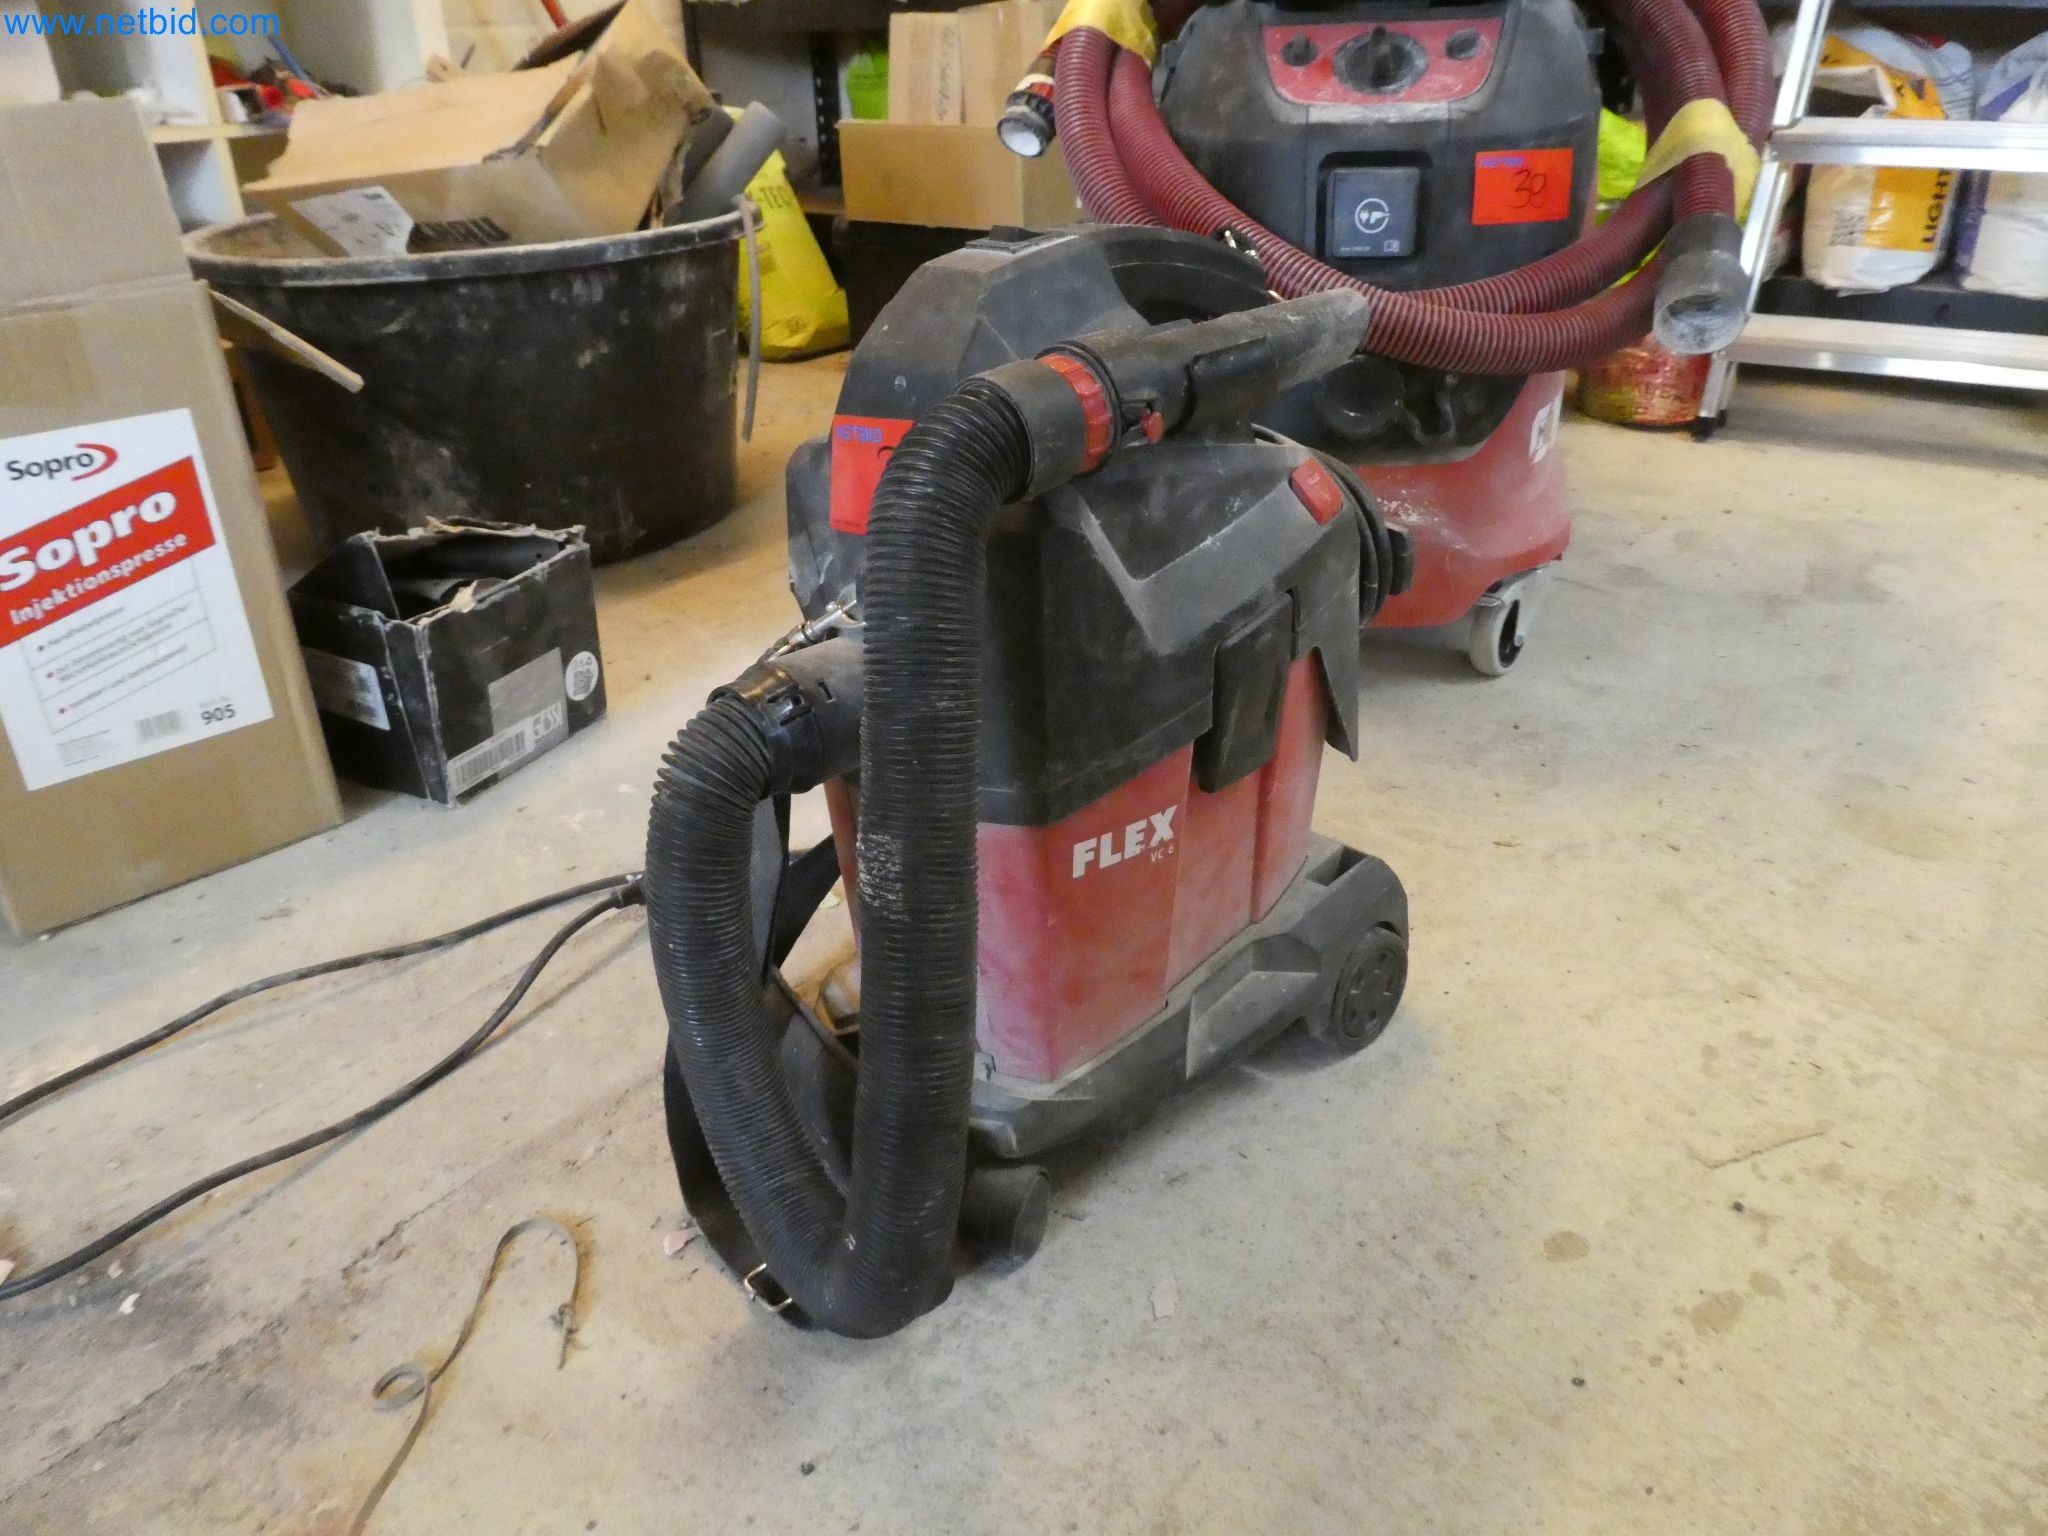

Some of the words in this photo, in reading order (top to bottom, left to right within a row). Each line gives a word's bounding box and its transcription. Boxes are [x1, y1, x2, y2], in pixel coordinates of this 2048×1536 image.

[5, 452, 95, 481] Sopro
[0, 491, 177, 592] Sopro
[9, 533, 188, 626] Injektionspresse
[200, 703, 237, 726] 905
[531, 700, 564, 739] GESSI
[1072, 804, 1178, 879] FLEX
[1150, 848, 1165, 862] VC
